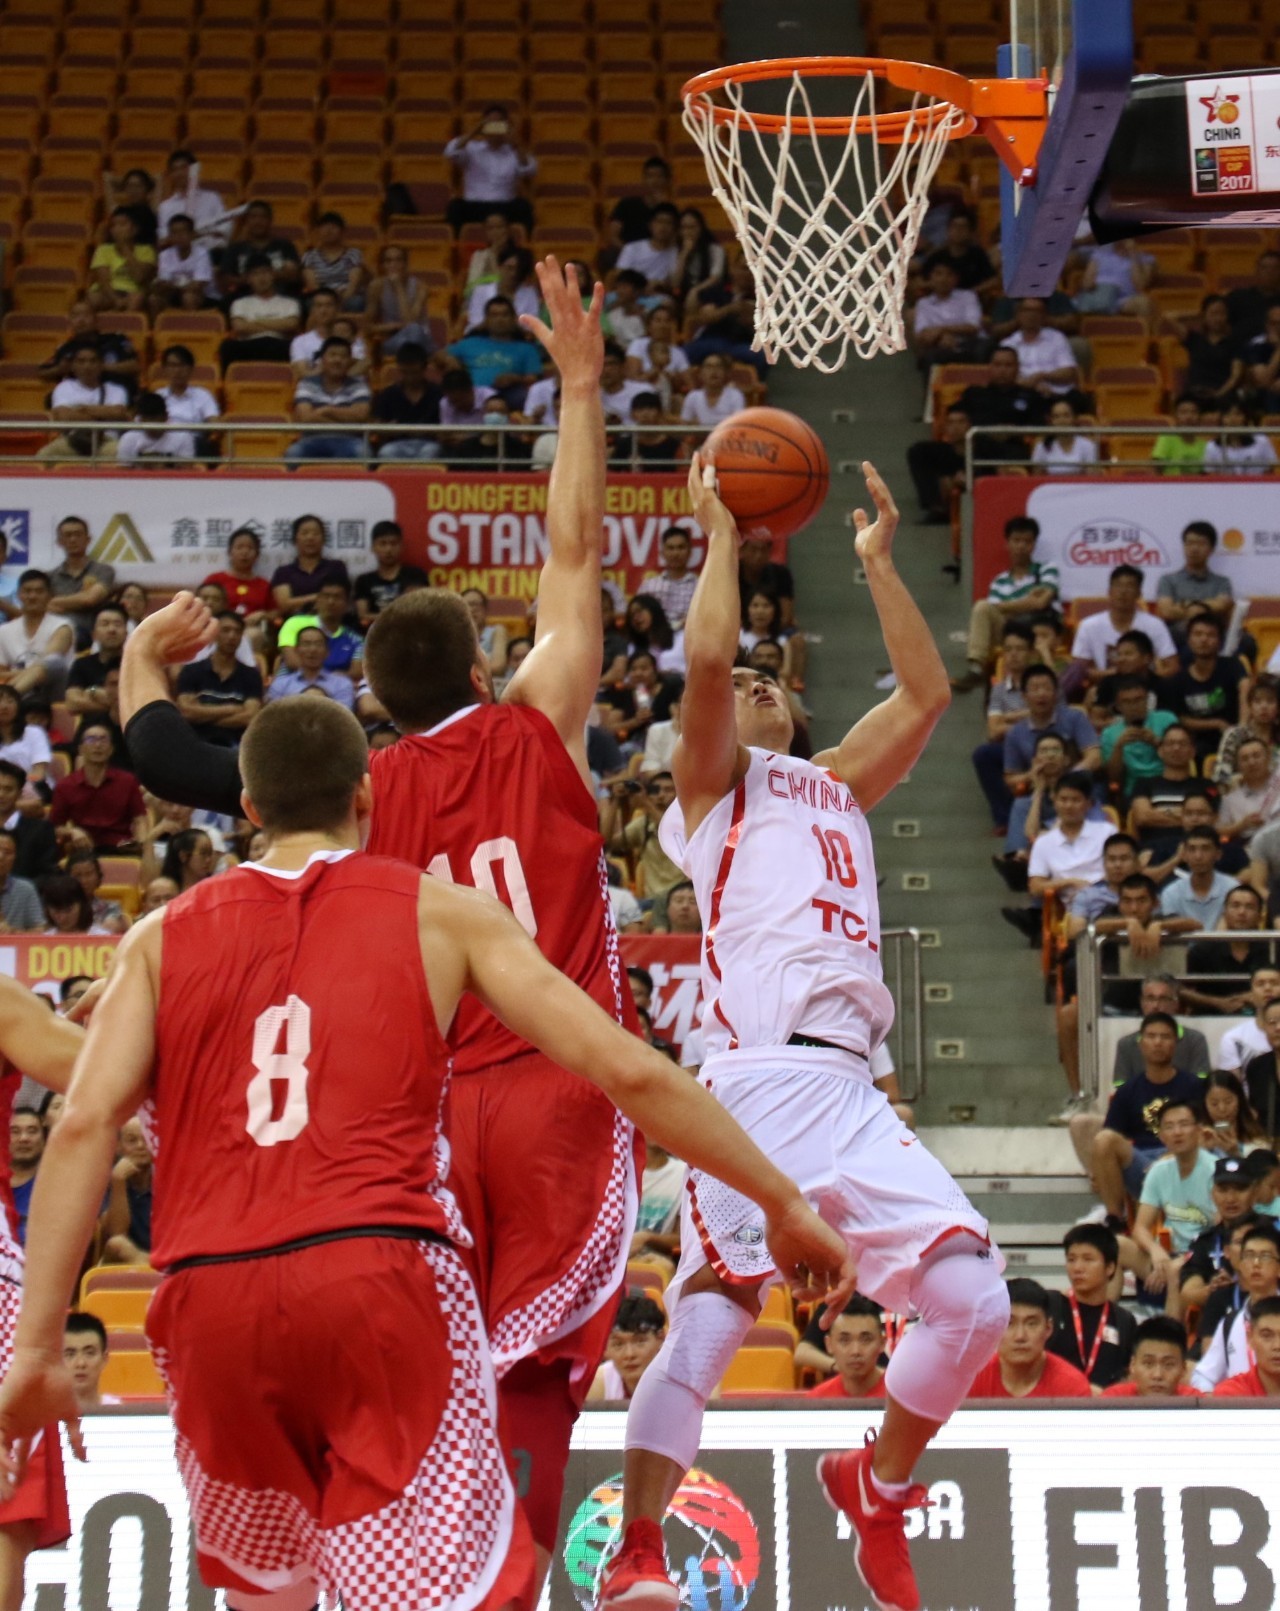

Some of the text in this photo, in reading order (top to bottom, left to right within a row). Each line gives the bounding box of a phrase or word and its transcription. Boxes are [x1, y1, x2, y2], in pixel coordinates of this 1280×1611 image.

[1204, 127, 1241, 141] CHINA
[1220, 175, 1251, 190] 2017
[427, 483, 548, 512] DONGFEN
[811, 823, 859, 889] 10
[245, 994, 311, 1147] 8
